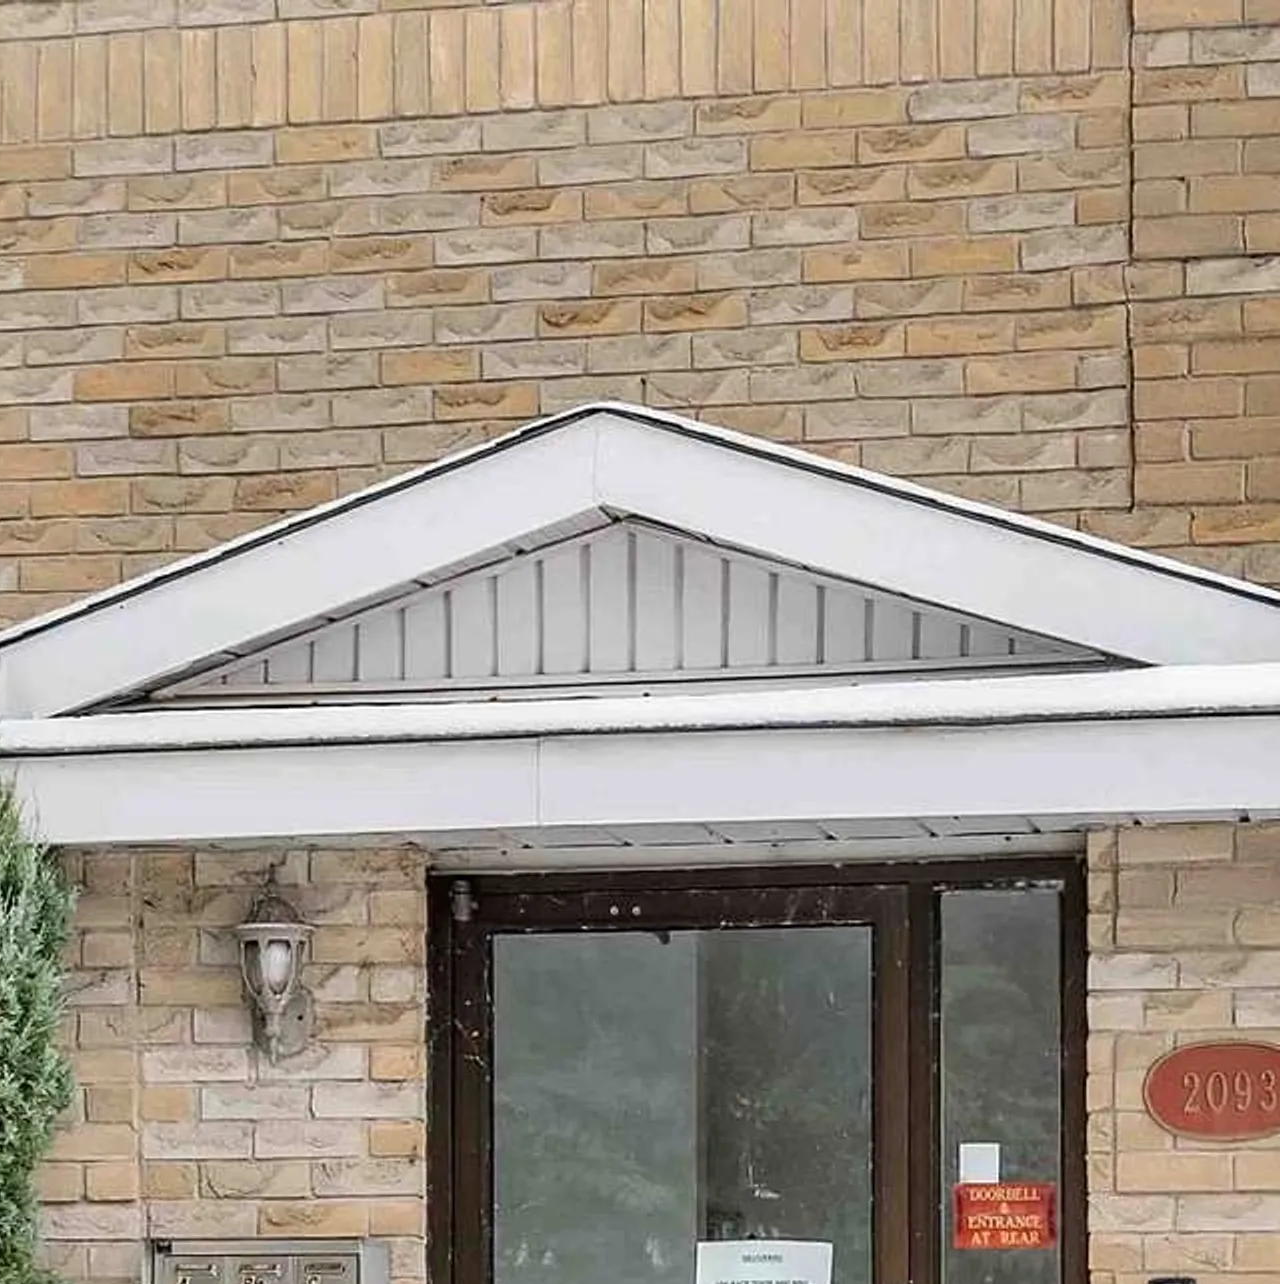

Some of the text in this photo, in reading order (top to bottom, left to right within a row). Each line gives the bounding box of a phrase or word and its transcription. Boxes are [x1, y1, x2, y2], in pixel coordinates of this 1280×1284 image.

[1182, 1069, 1278, 1114] 2093
[969, 1187, 1041, 1201] DOORBELL
[967, 1215, 1043, 1230] ENTRANCE
[971, 1231, 1040, 1245] AT REAR
